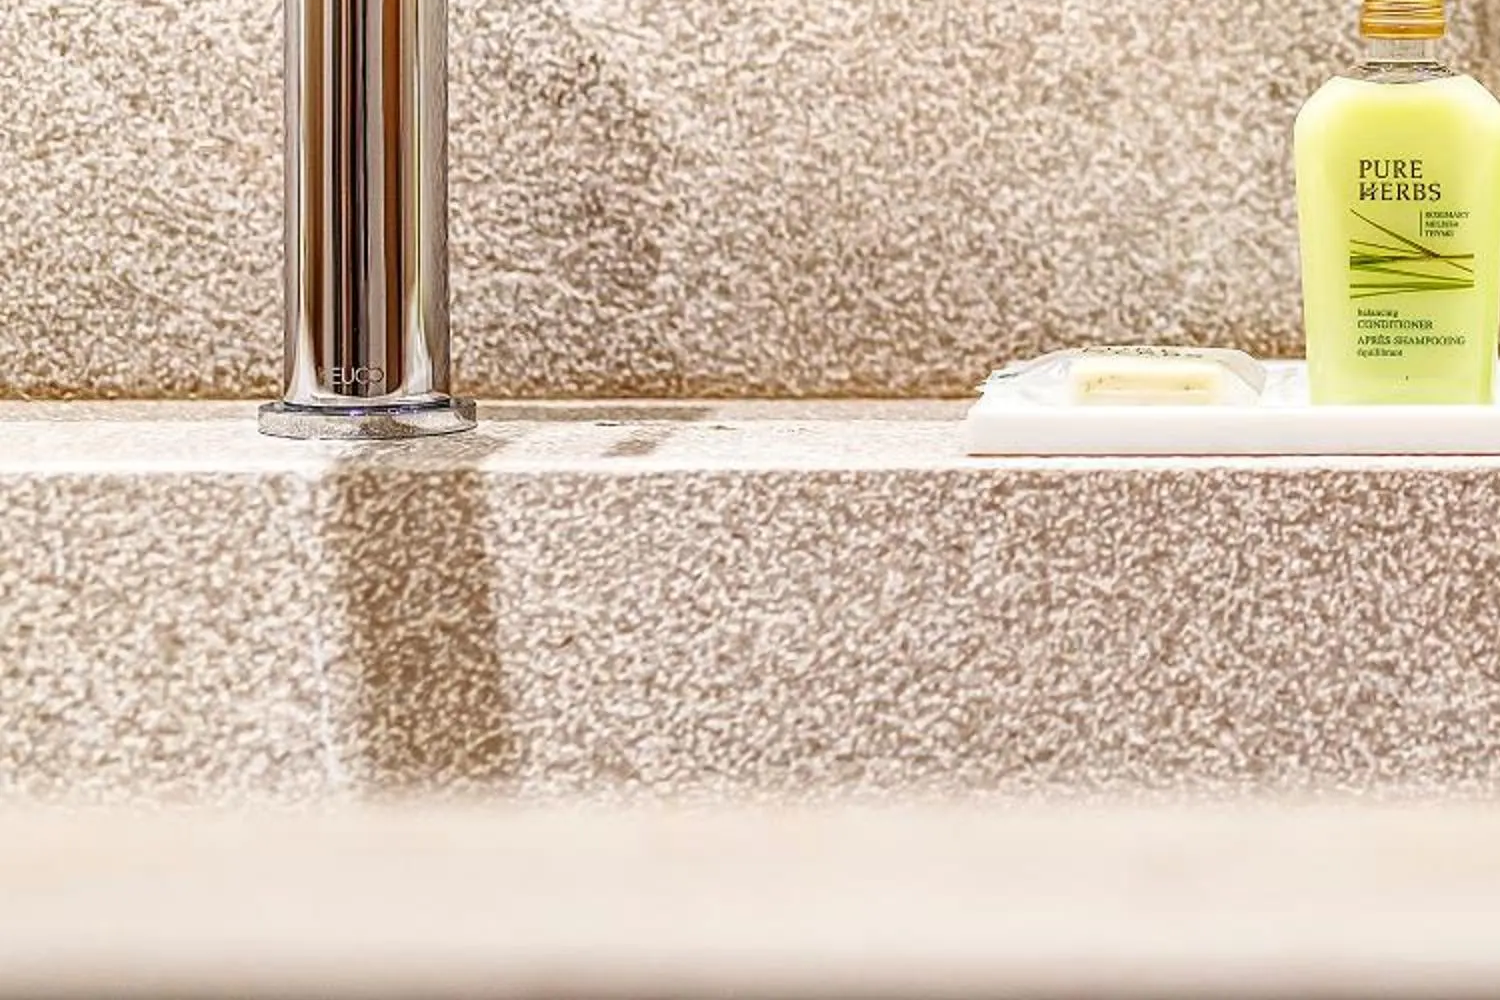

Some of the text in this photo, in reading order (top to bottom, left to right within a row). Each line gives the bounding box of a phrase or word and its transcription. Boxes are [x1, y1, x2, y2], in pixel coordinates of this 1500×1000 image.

[1359, 159, 1423, 179] PURE
[1359, 181, 1441, 201] HERBS
[1357, 319, 1433, 329] CONDITIONER
